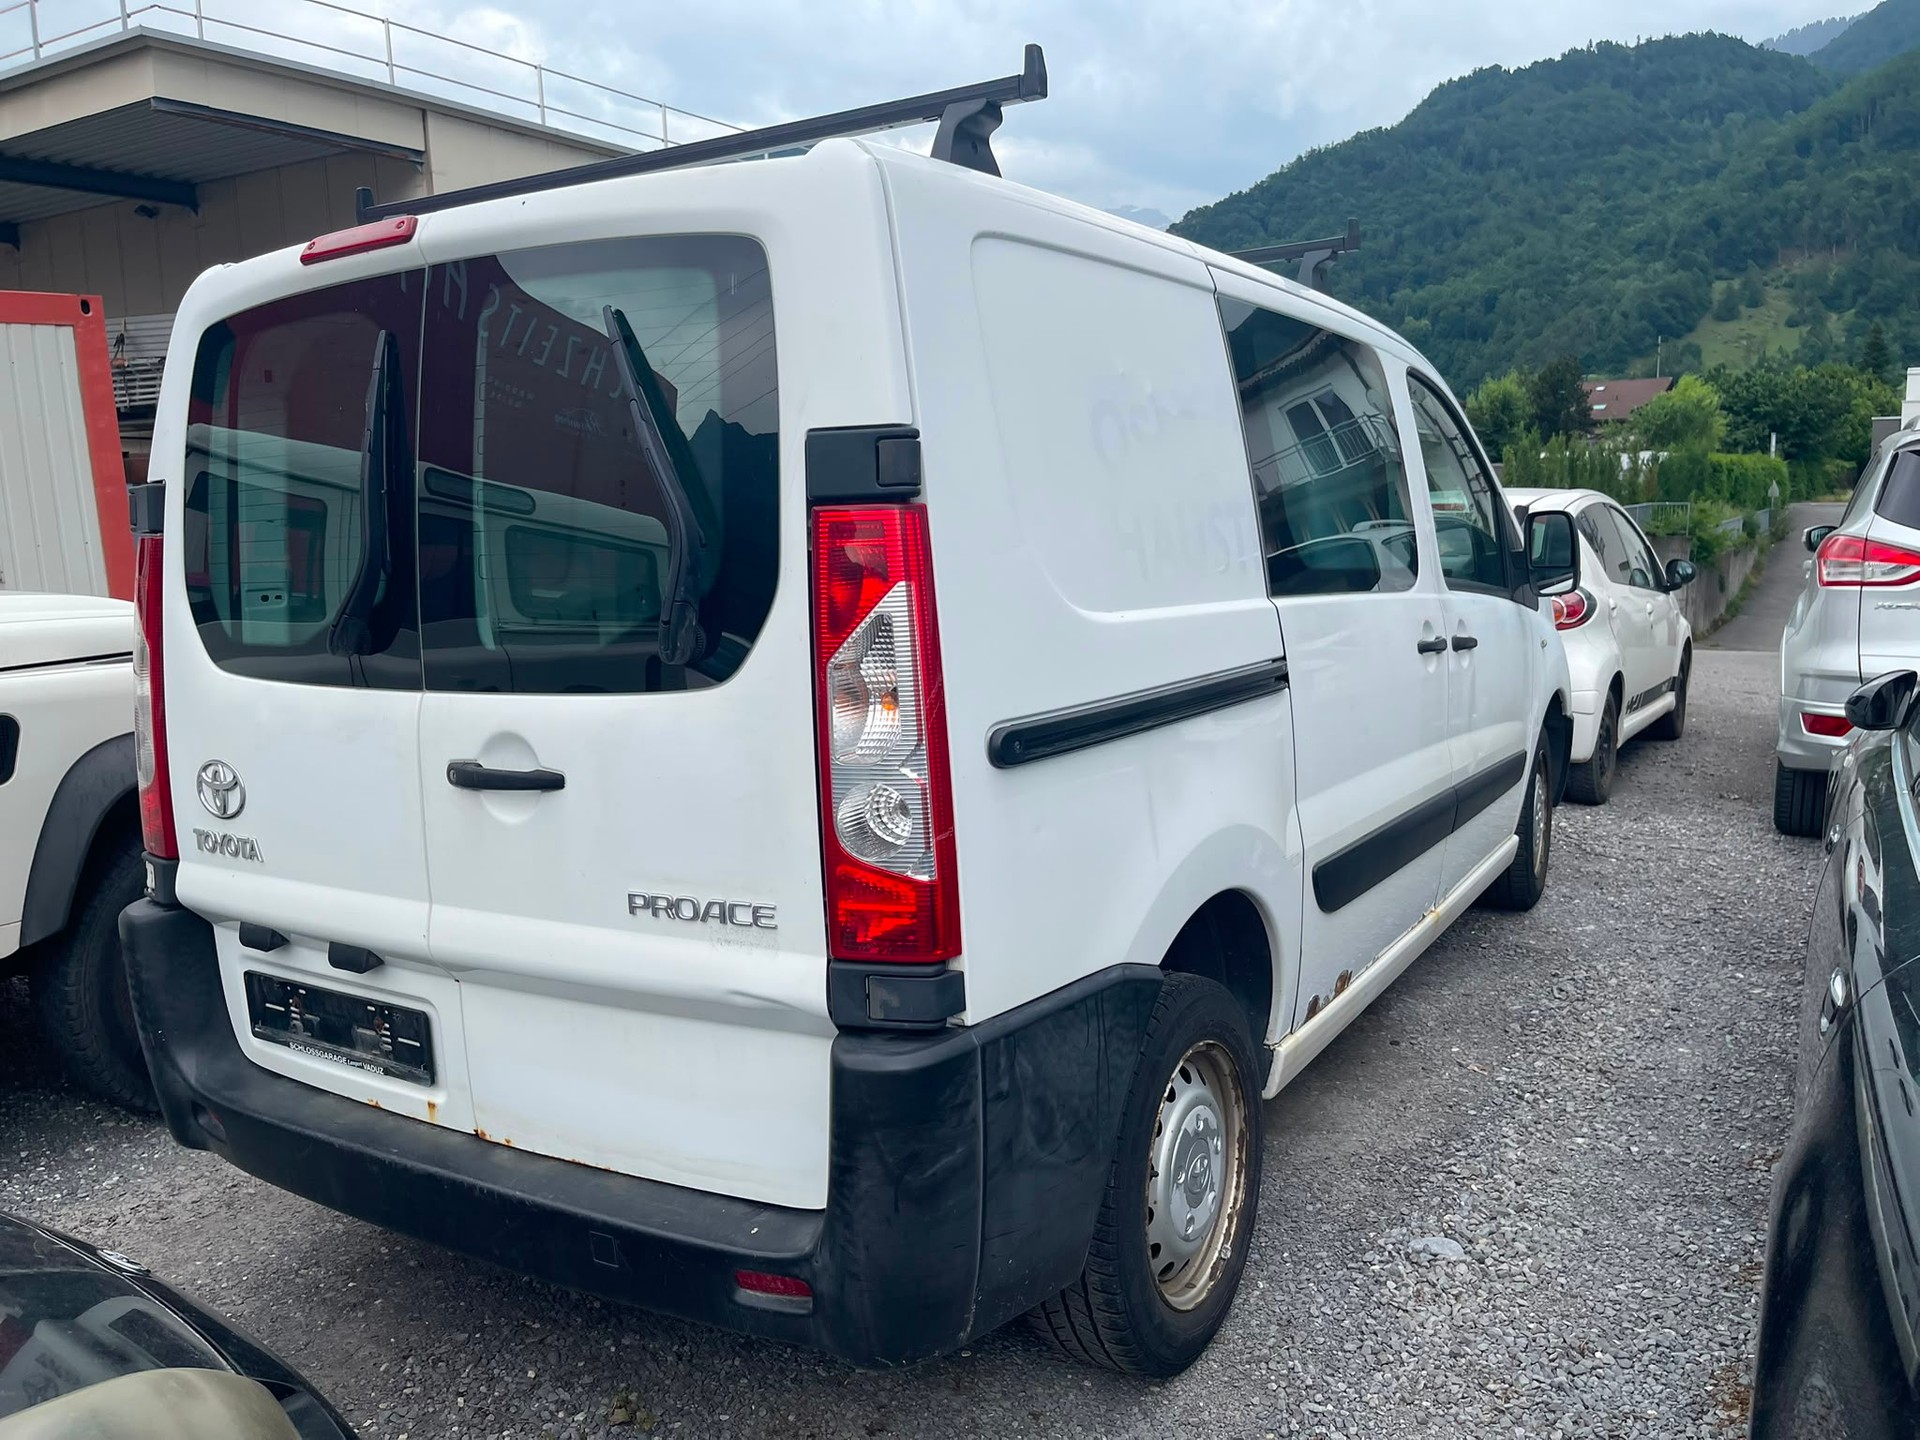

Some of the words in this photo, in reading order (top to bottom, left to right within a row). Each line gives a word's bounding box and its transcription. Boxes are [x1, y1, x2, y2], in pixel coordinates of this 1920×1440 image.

[193, 828, 264, 863] TOYOTA
[628, 890, 778, 930] PROACE
[289, 1041, 347, 1065] SCHLOSSGARAGE
[363, 1062, 384, 1075] VADUZ
